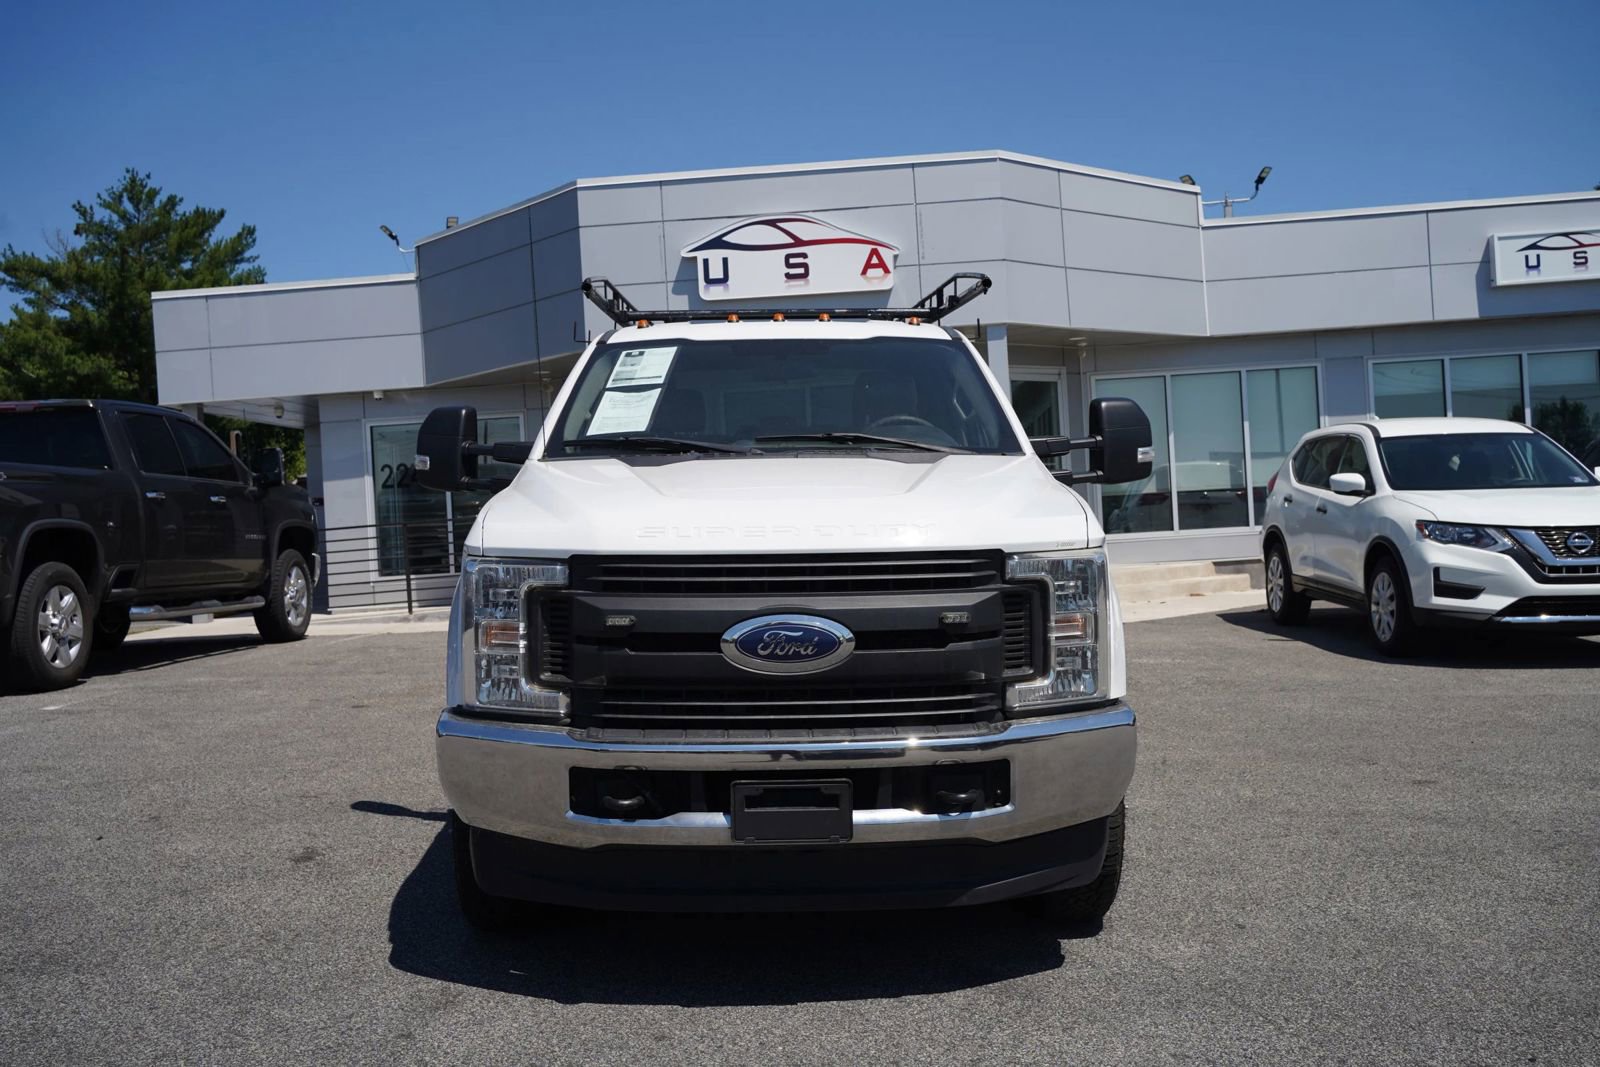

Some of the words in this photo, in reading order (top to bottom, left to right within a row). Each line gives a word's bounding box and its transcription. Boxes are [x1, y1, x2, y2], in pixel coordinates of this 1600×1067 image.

[635, 525, 802, 538] SUPER
[811, 523, 937, 537] DUTY
[757, 630, 818, 656] Ford
